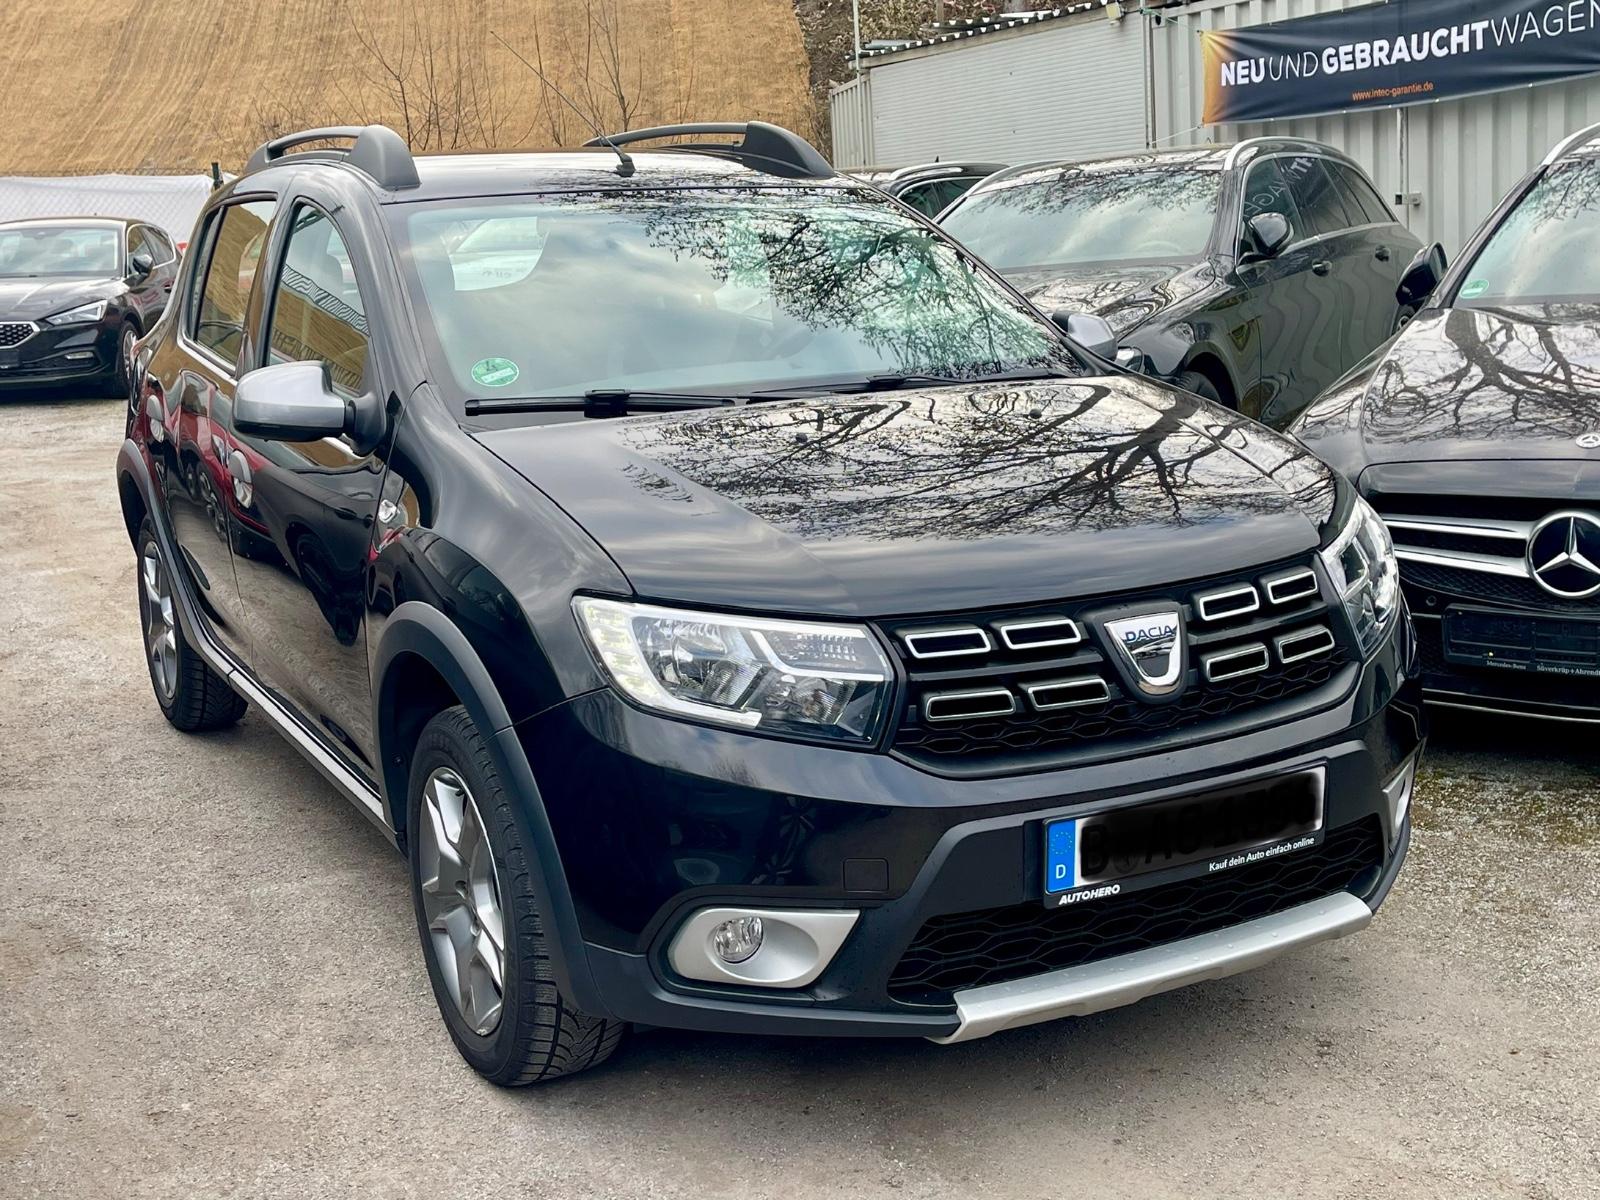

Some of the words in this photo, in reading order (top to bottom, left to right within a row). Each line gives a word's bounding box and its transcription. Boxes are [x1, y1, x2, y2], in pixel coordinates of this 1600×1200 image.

[1352, 81, 1434, 101] www.intec-garantie.de
[1125, 625, 1174, 641] DACIA
[1209, 859, 1228, 872] Kauf
[1229, 855, 1245, 867] dein
[1246, 852, 1265, 863] Auto
[1265, 842, 1292, 857] einfach
[1293, 837, 1315, 849] online
[1055, 864, 1067, 879] D
[1058, 884, 1121, 906] AUTOHERO
